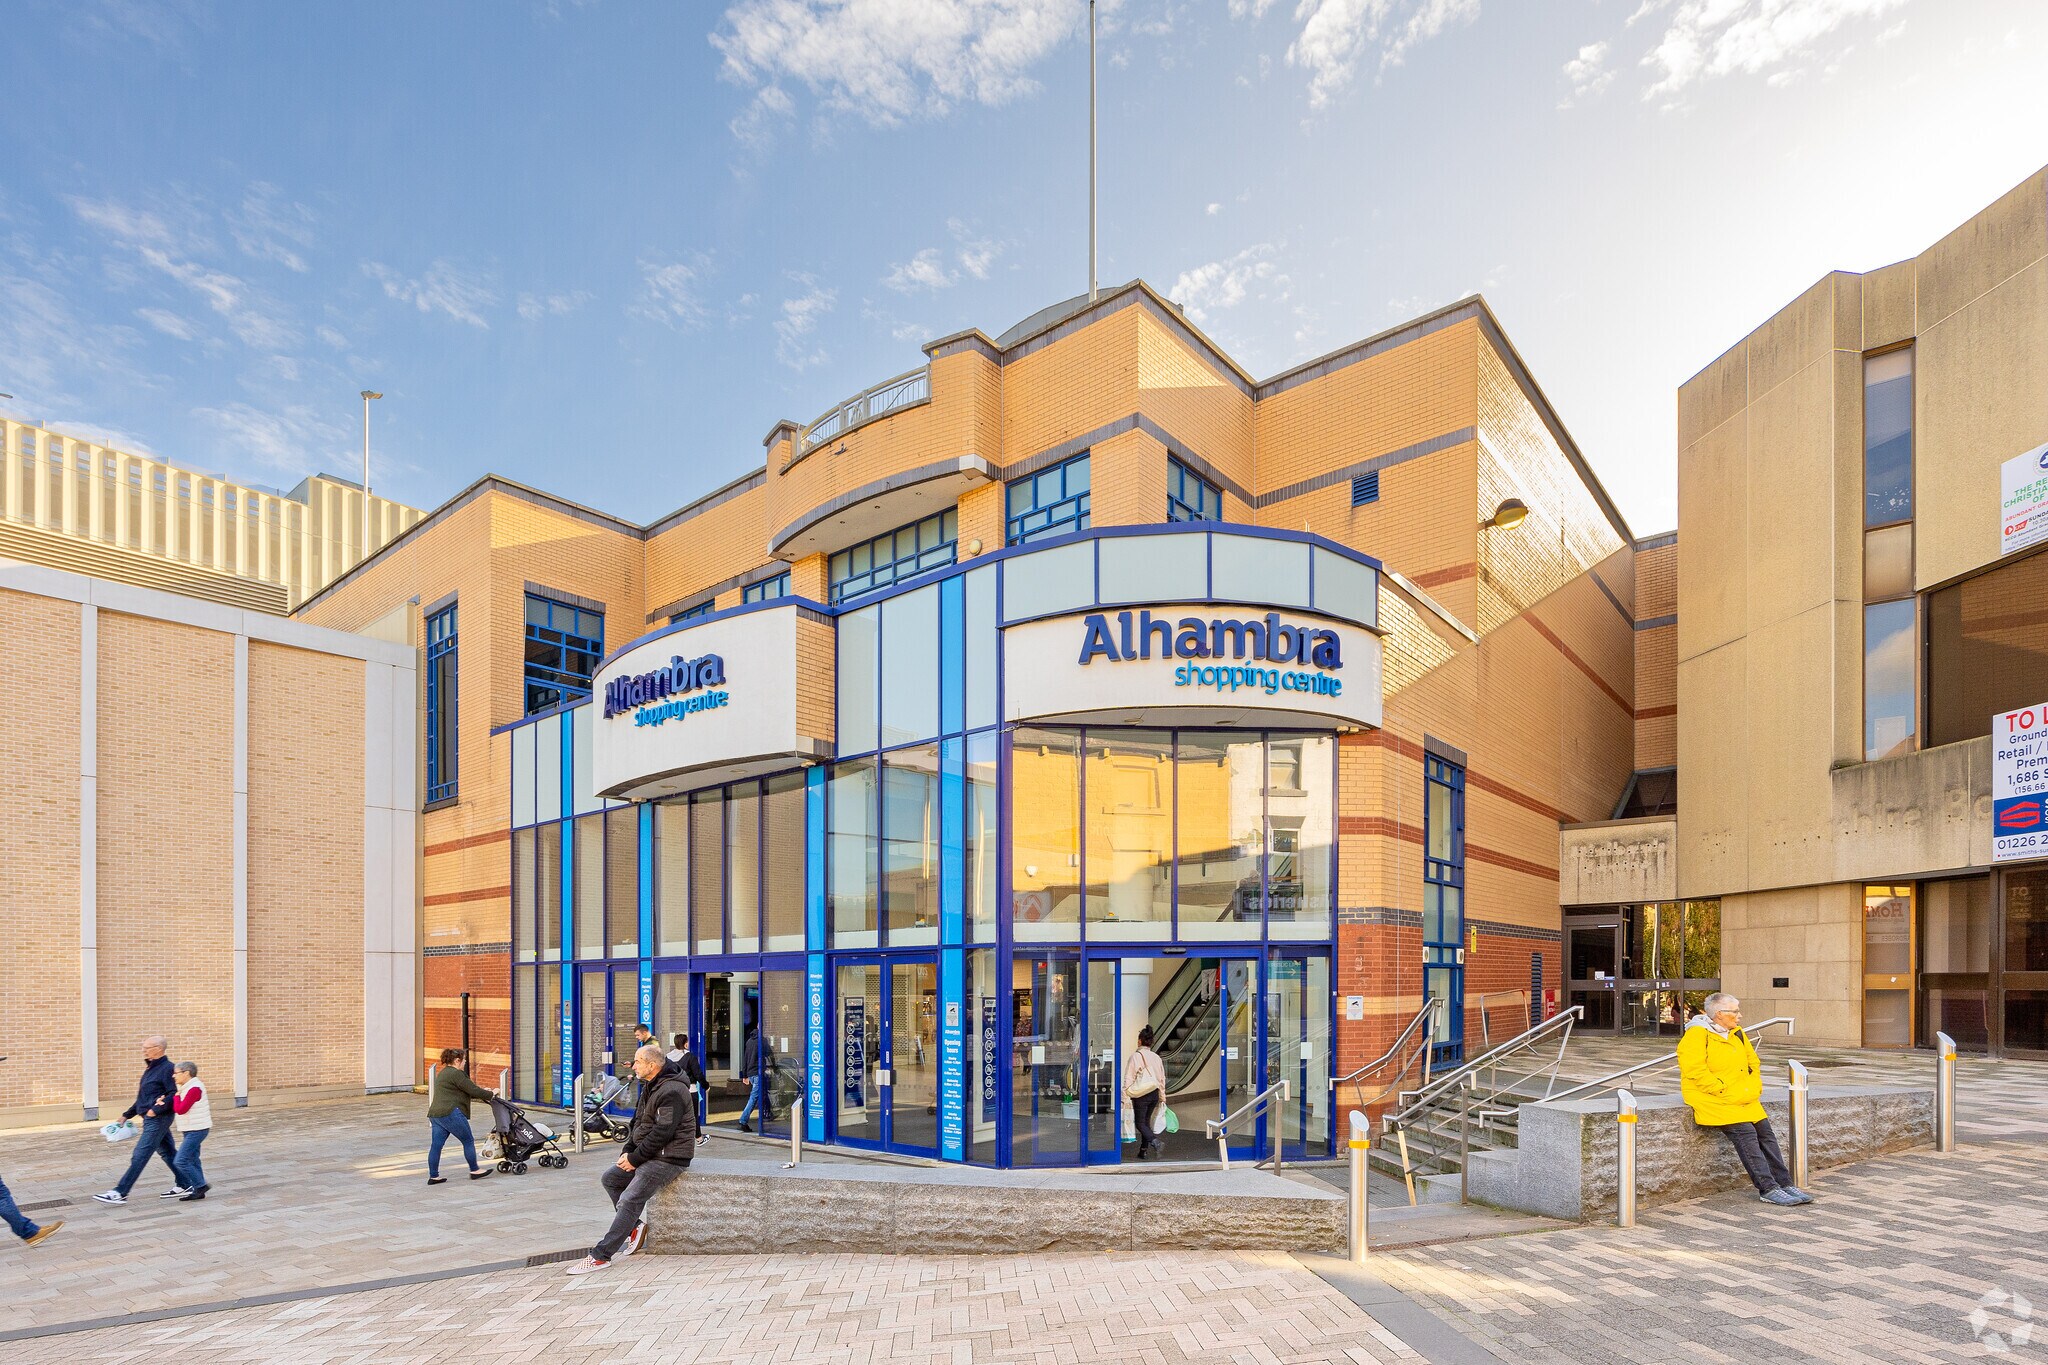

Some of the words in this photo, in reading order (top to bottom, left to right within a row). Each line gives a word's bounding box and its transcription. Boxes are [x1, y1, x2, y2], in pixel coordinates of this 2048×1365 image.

[2014, 484, 2033, 497] THE
[2033, 493, 2045, 503] OF
[2006, 506, 2036, 522] ABUNDANT
[1078, 610, 1343, 671] Alhambra
[603, 653, 726, 720] Alhambra
[1174, 660, 1279, 695] shopping
[1281, 670, 1342, 698] centre
[634, 699, 685, 727] shopping
[684, 690, 729, 714] centre
[2006, 710, 2035, 733] TO
[2009, 728, 2048, 744] Ground
[1998, 744, 2032, 761] Retail
[2016, 755, 2048, 770] Prem
[2008, 770, 2039, 786] 1,686
[2015, 782, 2046, 795] (156.66
[1997, 836, 2036, 850] 01226
[521, 1128, 534, 1139] Joie
